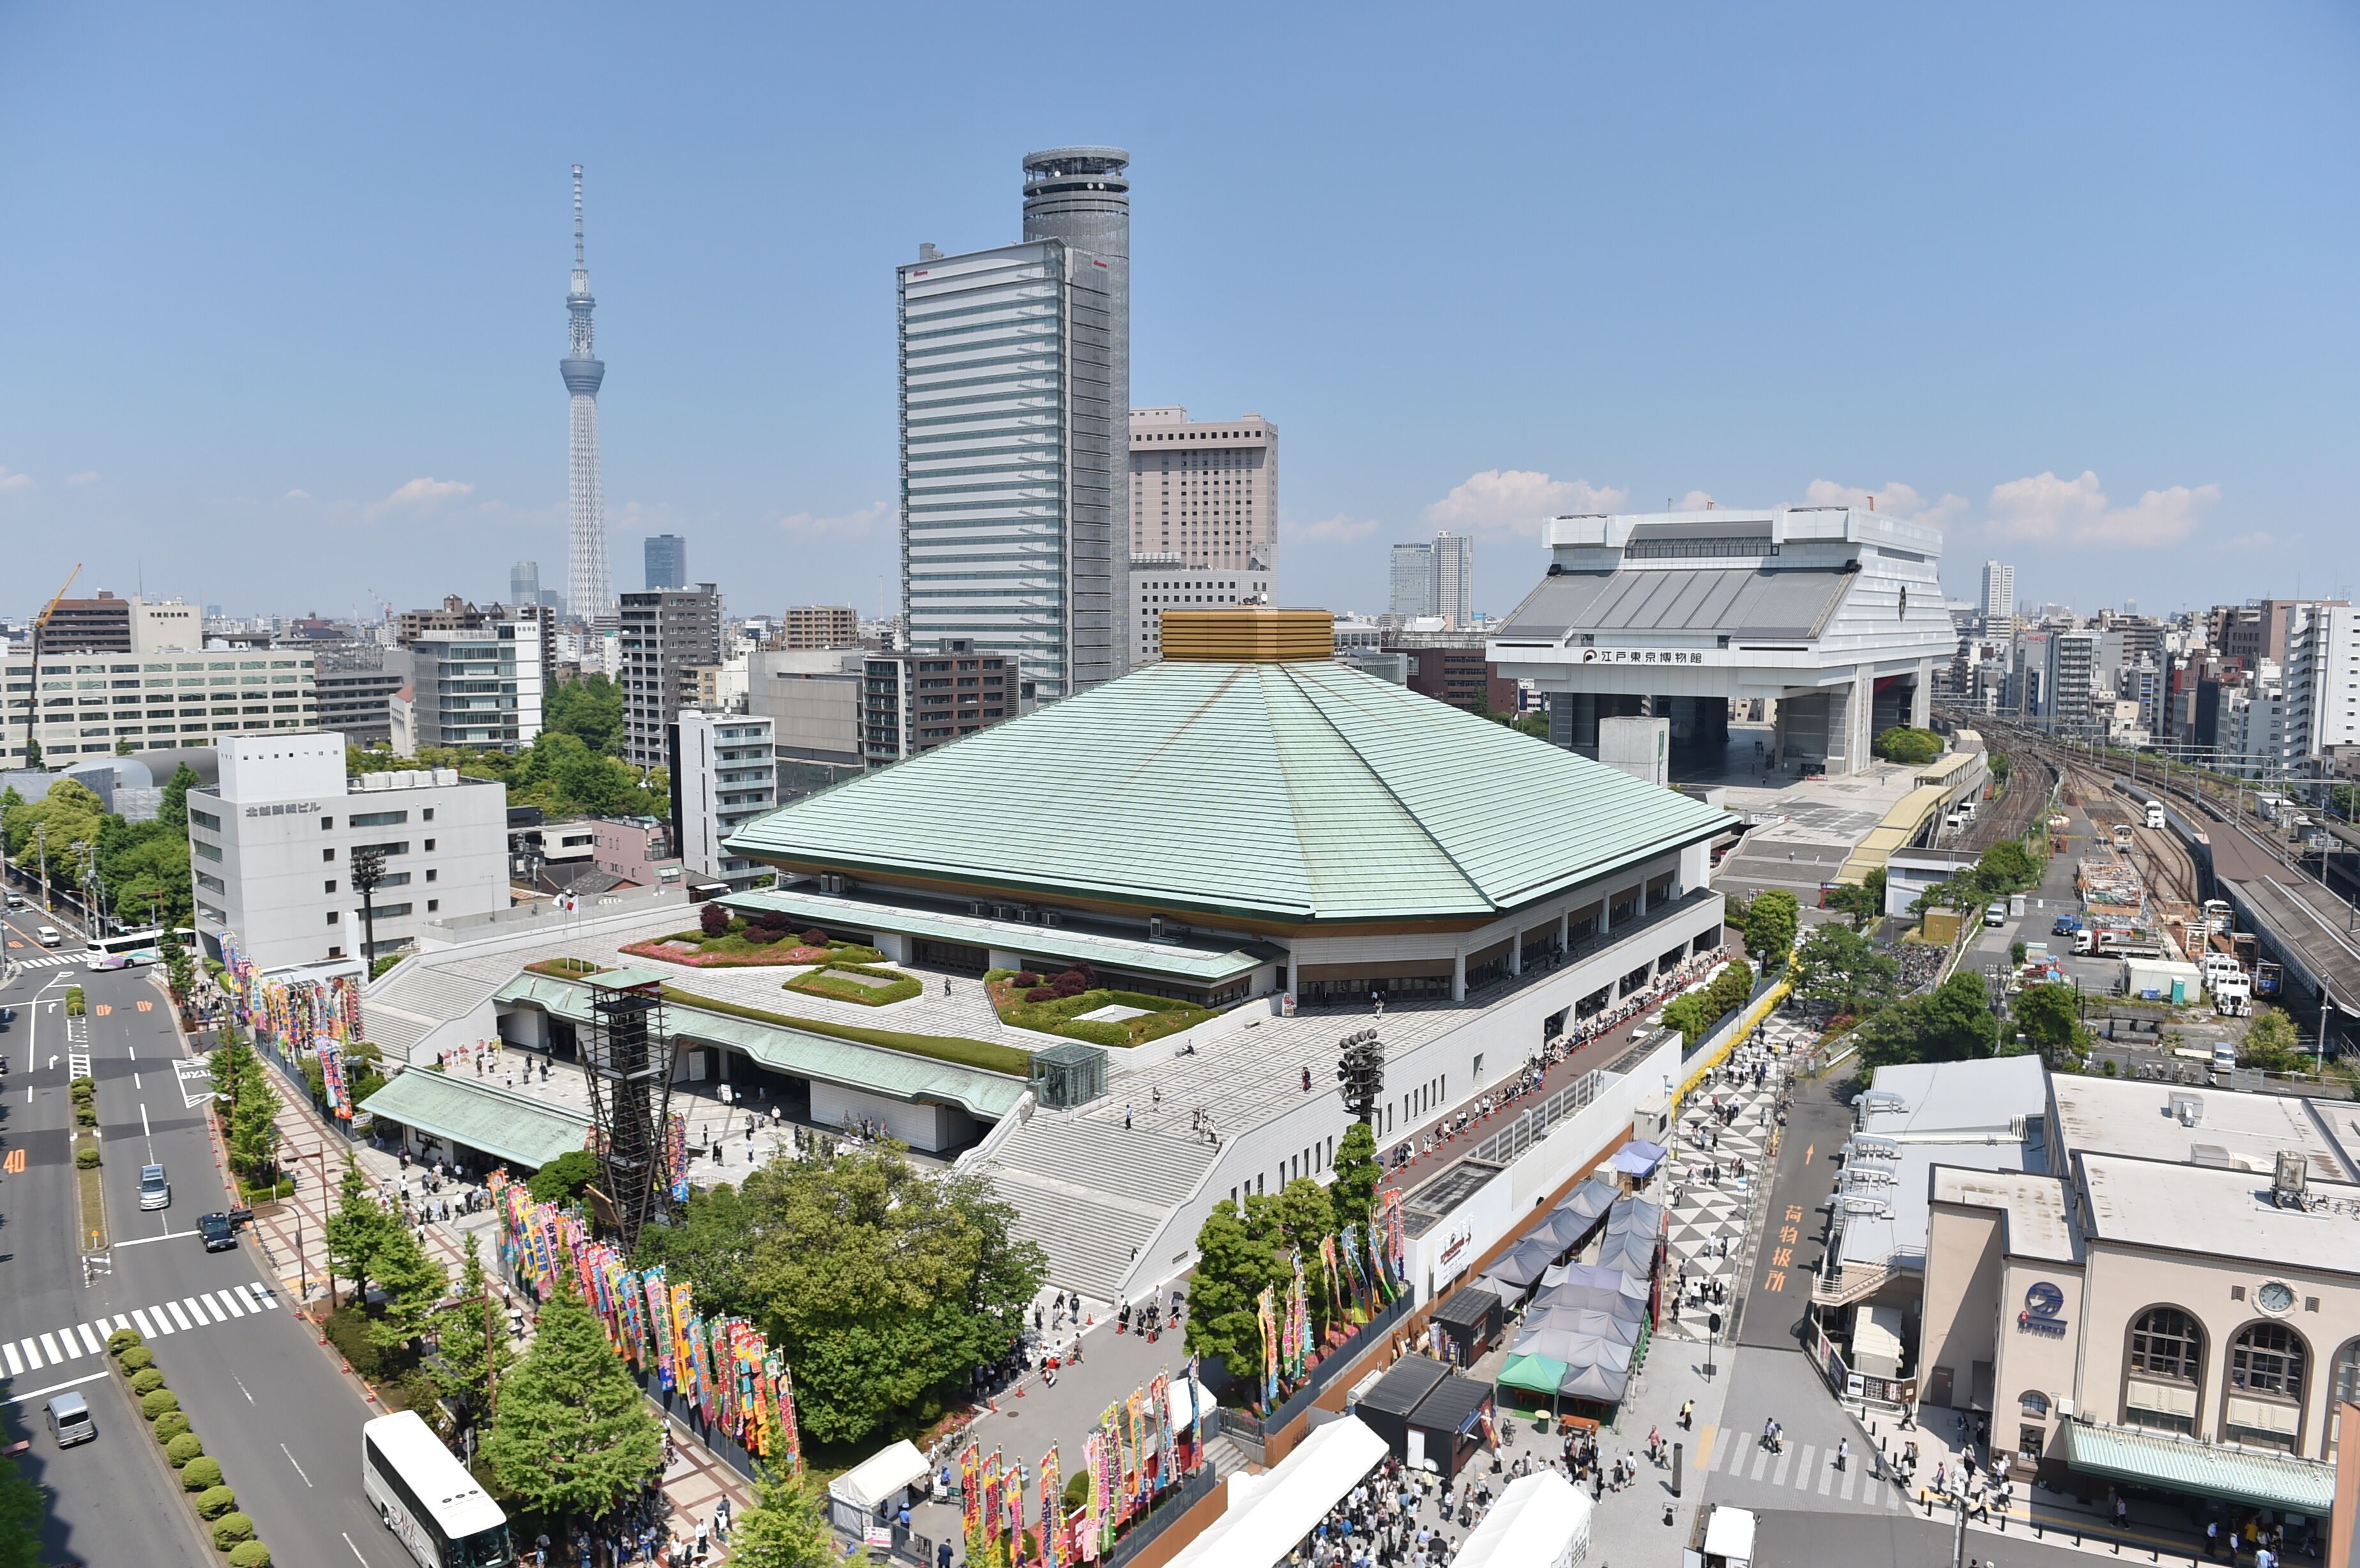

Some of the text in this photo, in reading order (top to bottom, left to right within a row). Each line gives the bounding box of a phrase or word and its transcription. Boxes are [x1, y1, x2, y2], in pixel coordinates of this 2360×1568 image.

[1601, 651, 1702, 663] 江戸東京博物館
[96, 1004, 112, 1016] 40
[137, 1000, 153, 1012] 40
[3, 1149, 25, 1174] 40
[1764, 1205, 1804, 1292] 荷物扱所
